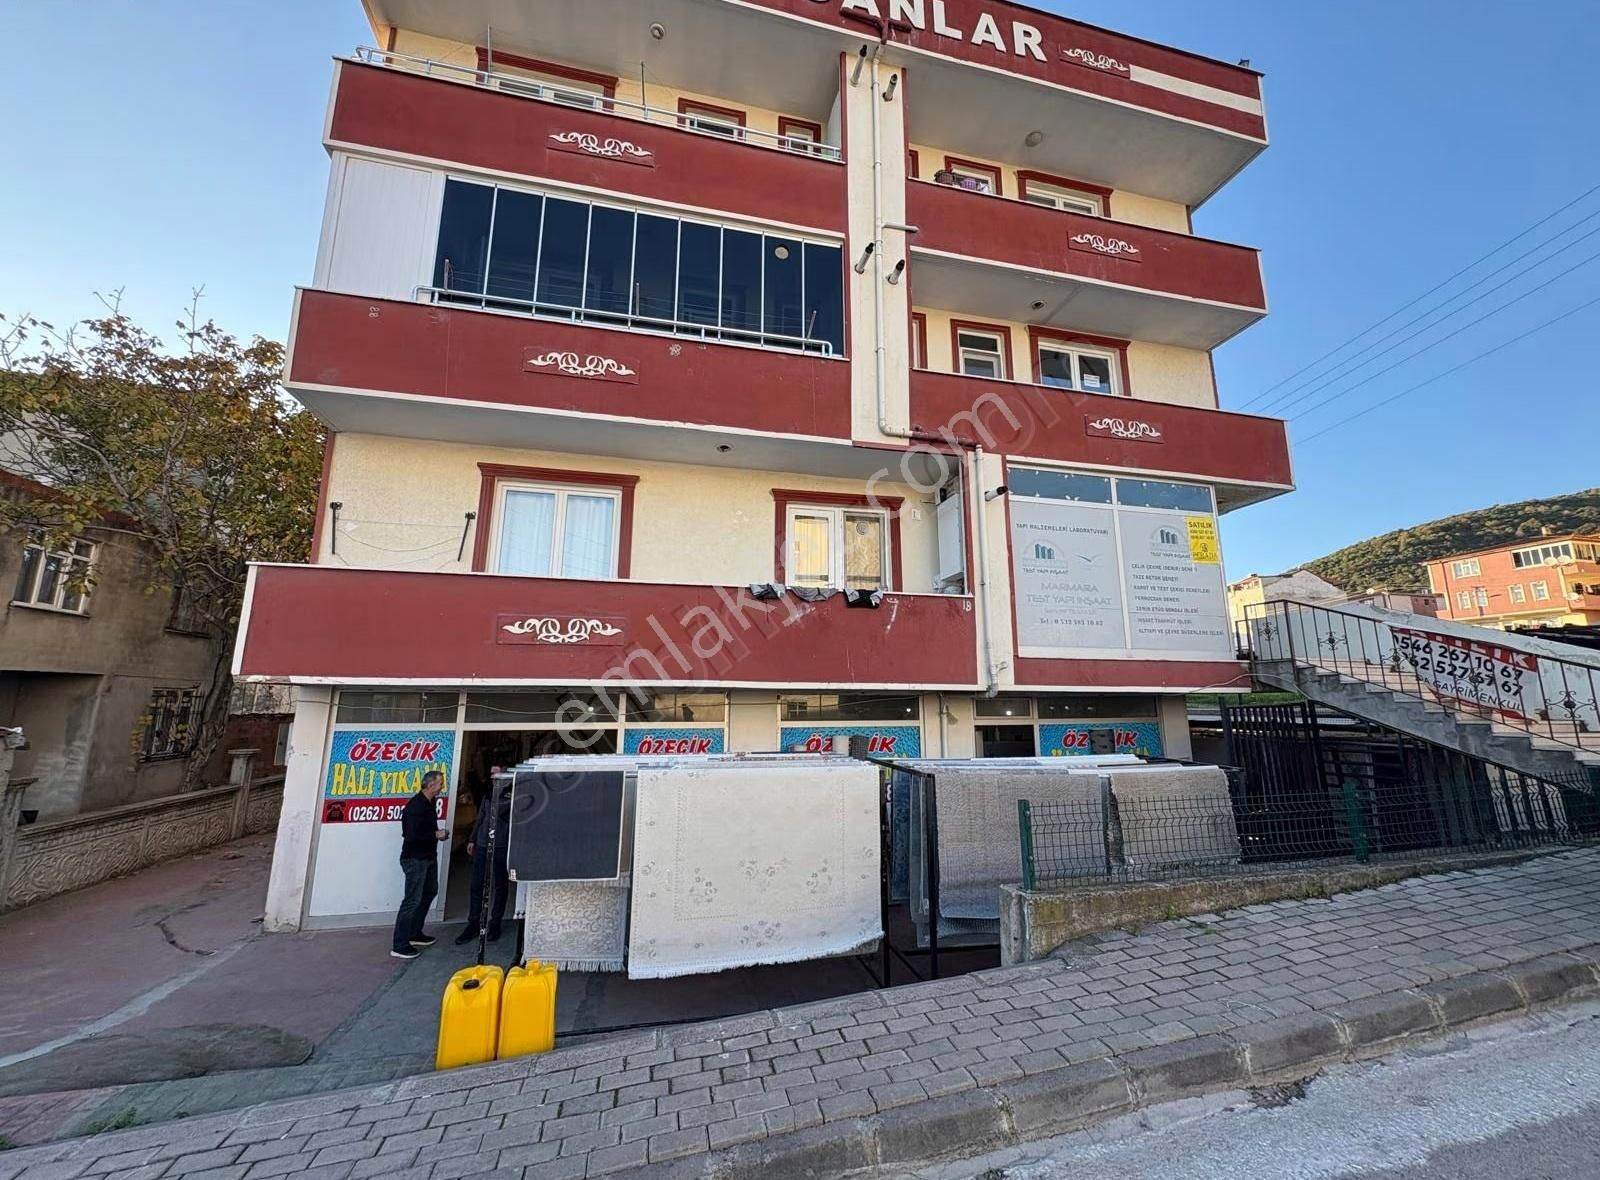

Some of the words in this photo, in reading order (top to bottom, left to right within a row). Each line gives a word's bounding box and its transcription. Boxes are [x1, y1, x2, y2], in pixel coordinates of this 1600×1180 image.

[808, 0, 1047, 62] ANLAR
[1041, 583, 1099, 593] MARMARA
[1026, 594, 1050, 603] TEST
[1052, 595, 1075, 604] YAPI
[1438, 645, 1470, 663] 267
[1474, 656, 1496, 672] 10
[1500, 666, 1524, 681] 67
[1434, 661, 1469, 679] 527
[1500, 680, 1524, 697] 67
[805, 733, 897, 754] ÖZİK
[1062, 728, 1138, 749] ÖZİK
[330, 763, 377, 796] HALI
[380, 762, 449, 795] YIKAA
[348, 805, 386, 821] (0262)
